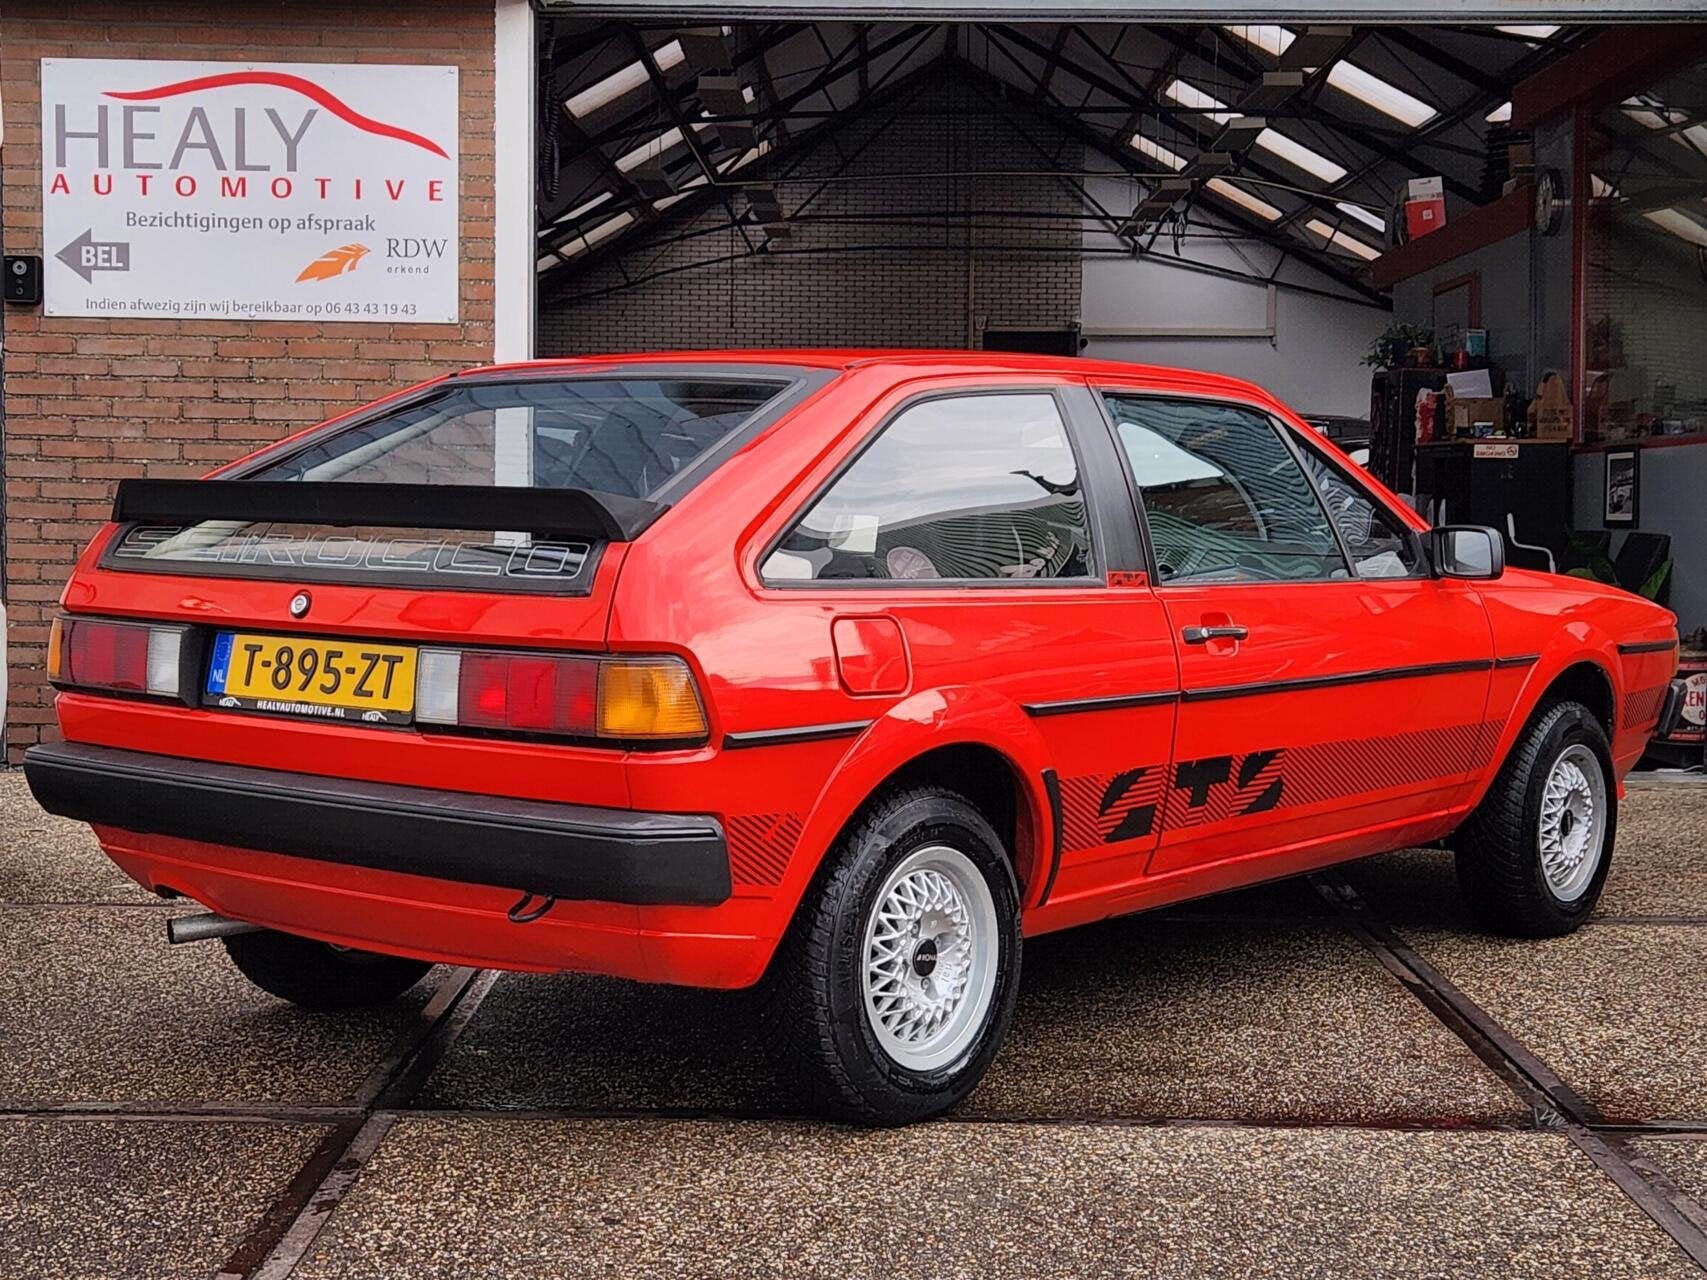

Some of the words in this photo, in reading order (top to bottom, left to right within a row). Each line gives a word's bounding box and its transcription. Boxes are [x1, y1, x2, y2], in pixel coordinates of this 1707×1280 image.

[55, 104, 319, 172] HEALY
[50, 173, 444, 202] AUTOMOTIVE
[126, 211, 263, 233] Bezichtigingen
[268, 219, 292, 234] op
[296, 214, 376, 234] afspraak
[80, 246, 124, 267] BEL
[386, 238, 448, 259] RDW
[387, 264, 430, 274] erkend
[86, 298, 127, 310] Indien
[130, 299, 181, 313] afwezig
[184, 300, 207, 314] zijn
[210, 300, 230, 315] wij
[233, 300, 302, 314] bereikbaar
[305, 304, 323, 316] op
[325, 302, 342, 314] 06
[344, 303, 361, 314] 43
[363, 303, 380, 315] 43
[384, 304, 399, 315] 19
[401, 304, 418, 316] 43
[212, 669, 225, 683] NL
[244, 644, 404, 700] T-895-ZT
[256, 700, 346, 718] HEALYAUTOMOTIVE.NL
